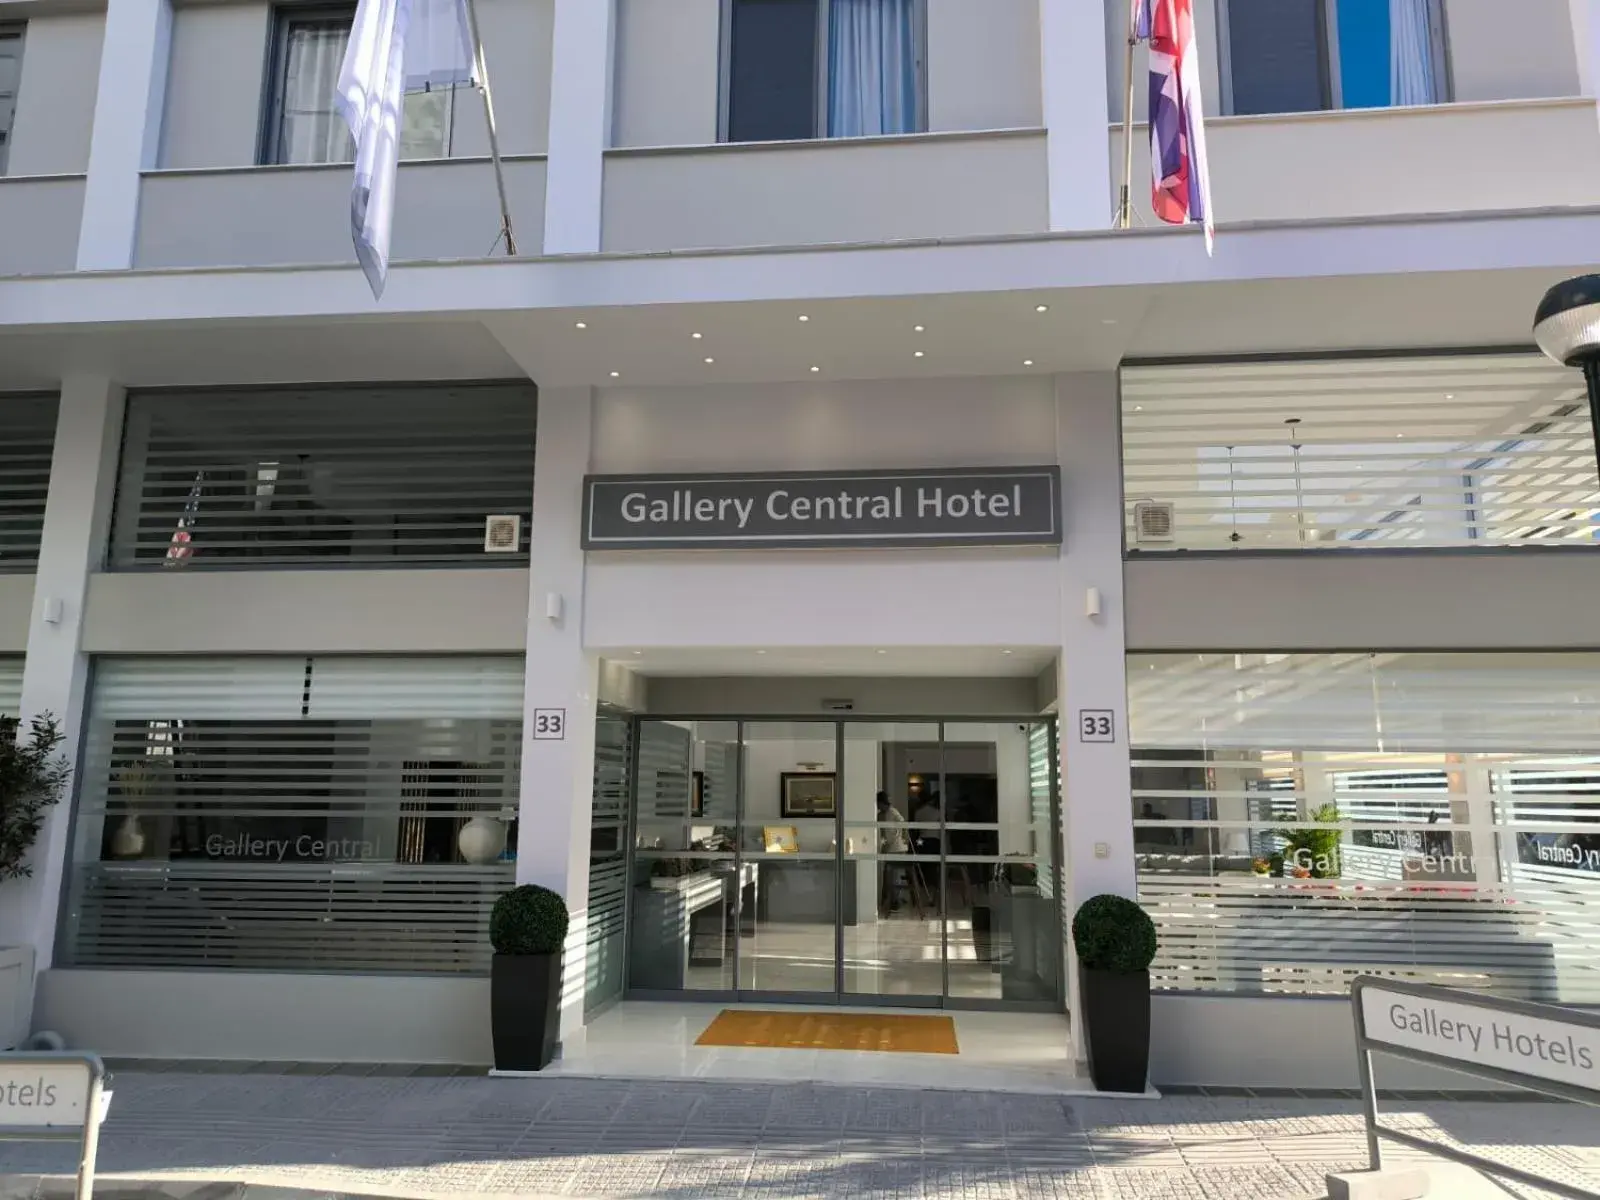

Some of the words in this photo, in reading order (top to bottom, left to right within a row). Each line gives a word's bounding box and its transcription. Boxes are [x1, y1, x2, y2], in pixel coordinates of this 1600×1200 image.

[620, 489, 754, 528] Gallery
[766, 486, 901, 521] Central
[917, 484, 1021, 518] Hotel
[537, 715, 561, 733] 33
[1084, 717, 1110, 735] 33
[206, 832, 289, 863] Gallery
[296, 835, 381, 857] Central
[1389, 1004, 1482, 1052] Gallery
[1492, 1022, 1594, 1070] Hotels
